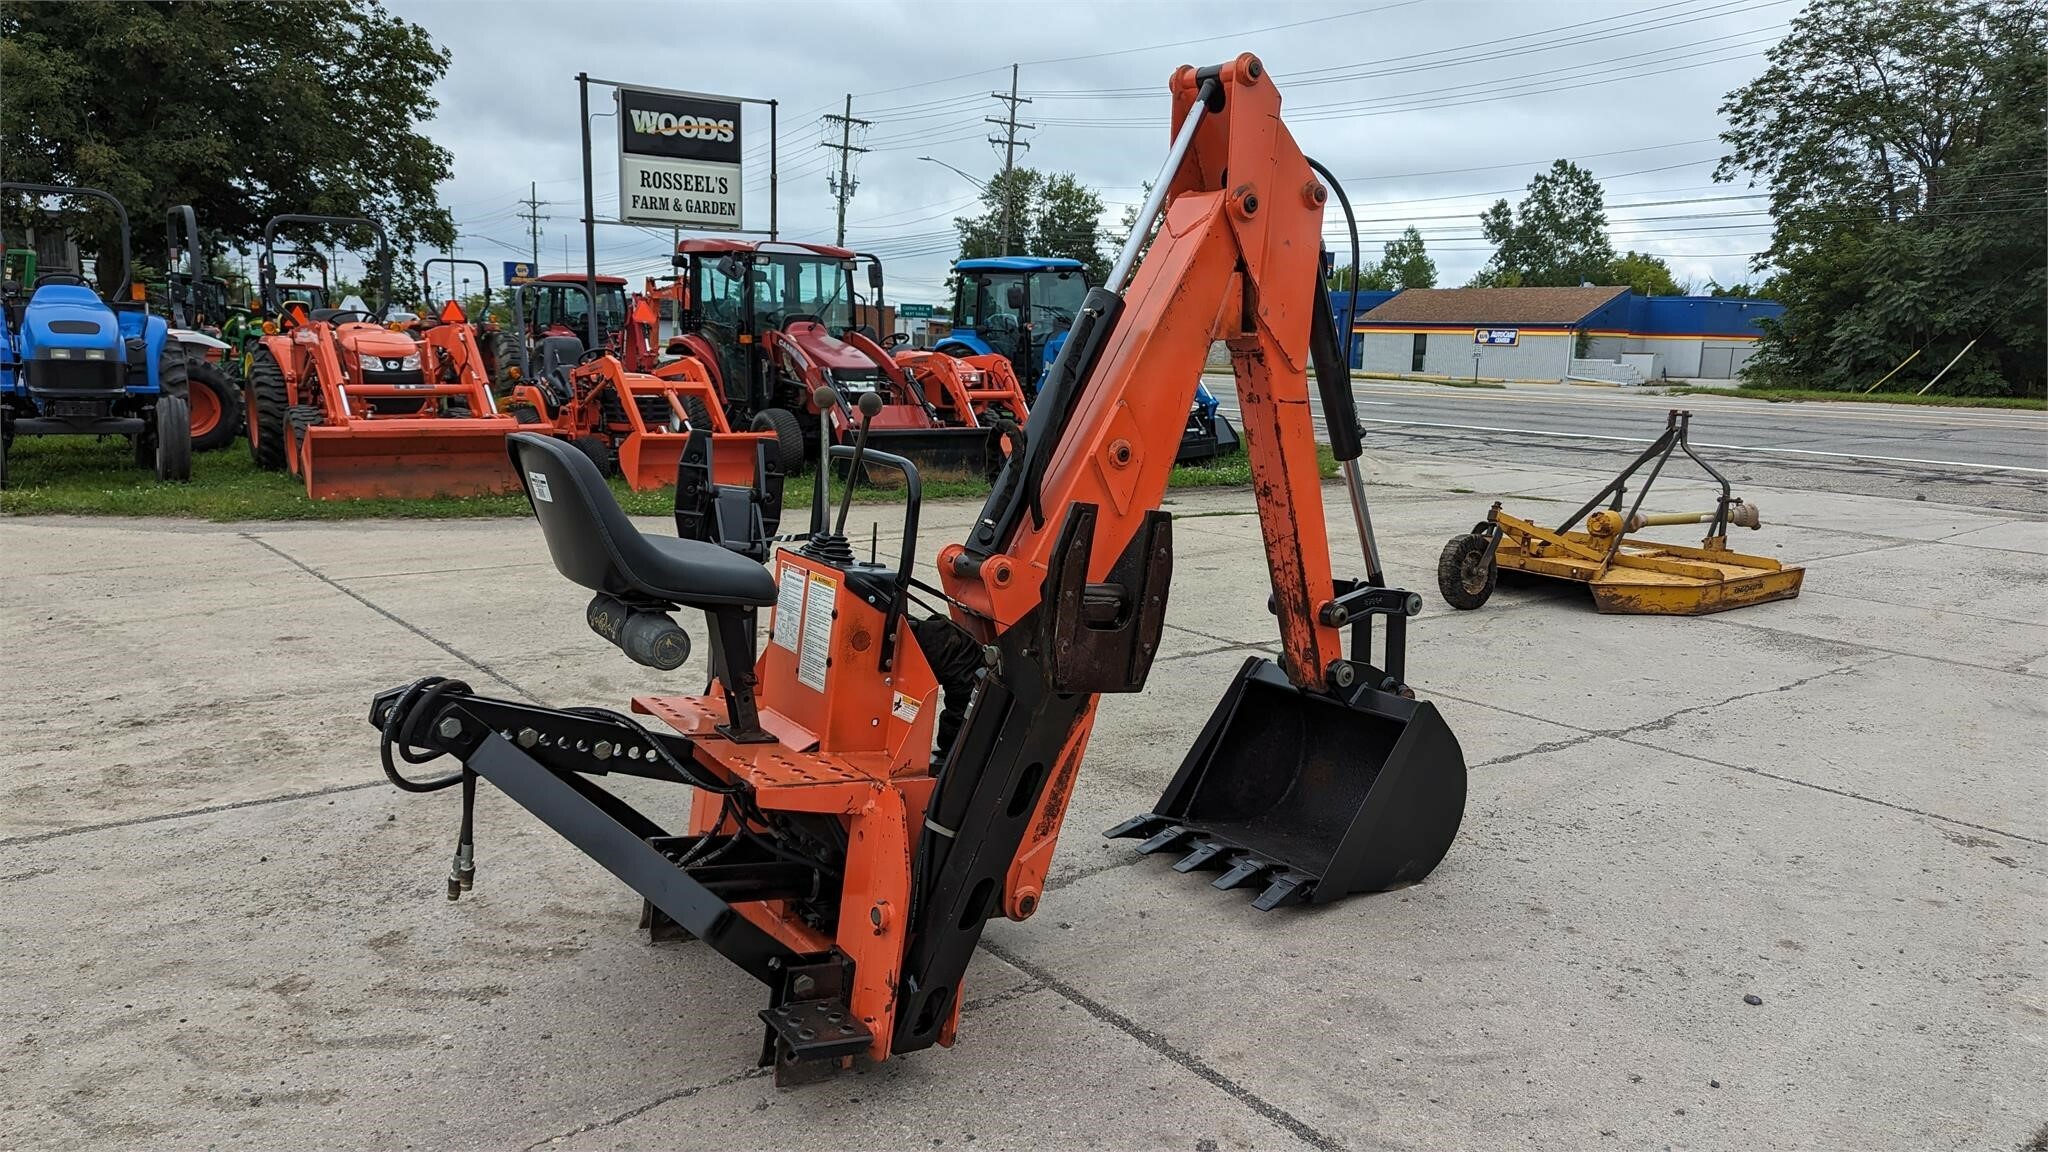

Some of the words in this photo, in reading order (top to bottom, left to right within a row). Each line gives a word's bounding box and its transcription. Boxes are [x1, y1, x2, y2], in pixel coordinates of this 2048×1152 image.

[630, 109, 734, 142] WOODS
[640, 170, 728, 194] ROSSEEL'S
[632, 195, 669, 211] FARM
[673, 198, 682, 212] &
[686, 199, 736, 216] GARDEN
